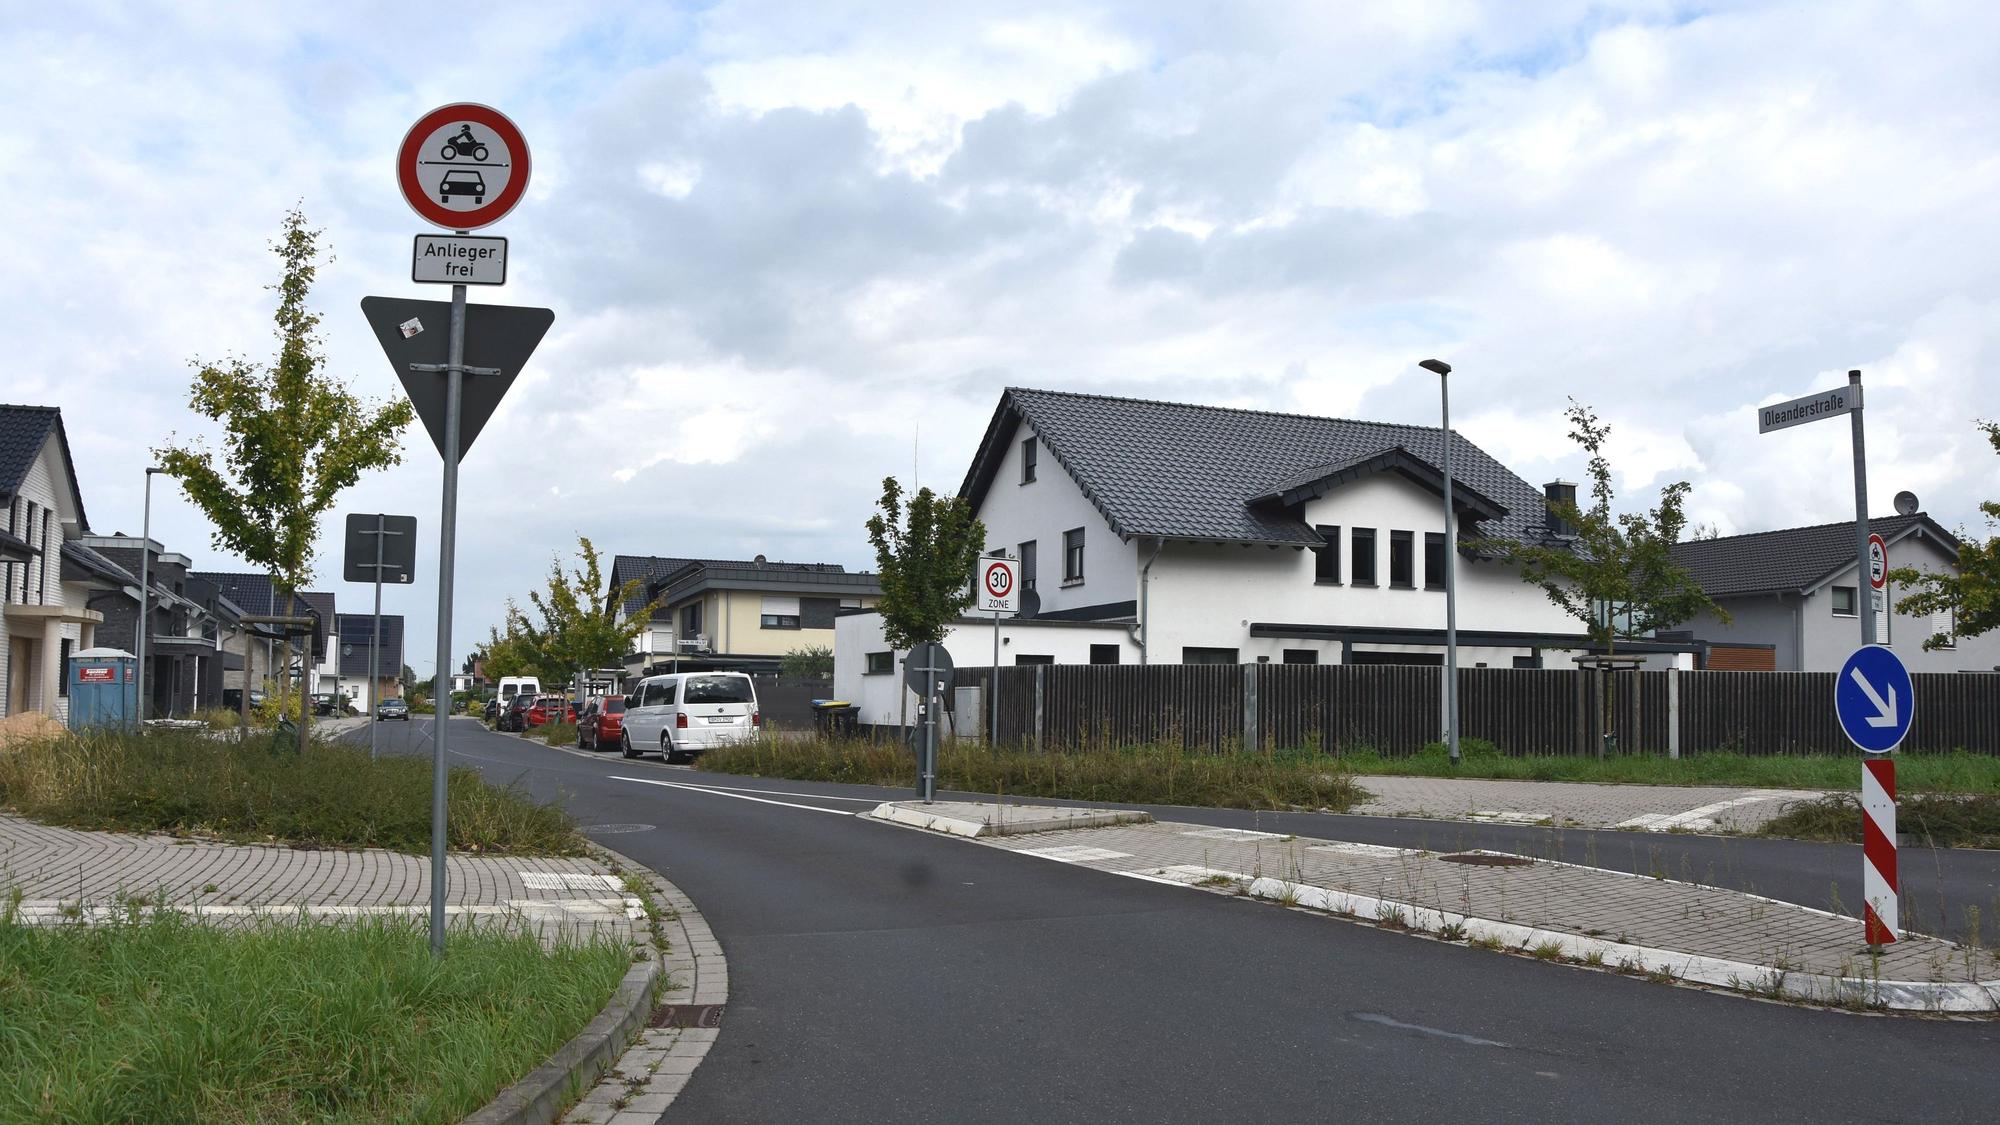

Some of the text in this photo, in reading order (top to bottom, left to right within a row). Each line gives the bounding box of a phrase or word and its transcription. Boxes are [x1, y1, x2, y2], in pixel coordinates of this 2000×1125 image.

[424, 242, 497, 262] Anlieger
[445, 261, 474, 277] frei
[1764, 394, 1844, 426] Oleanderstraße
[991, 571, 1008, 588] 30
[988, 599, 1009, 609] ZONE
